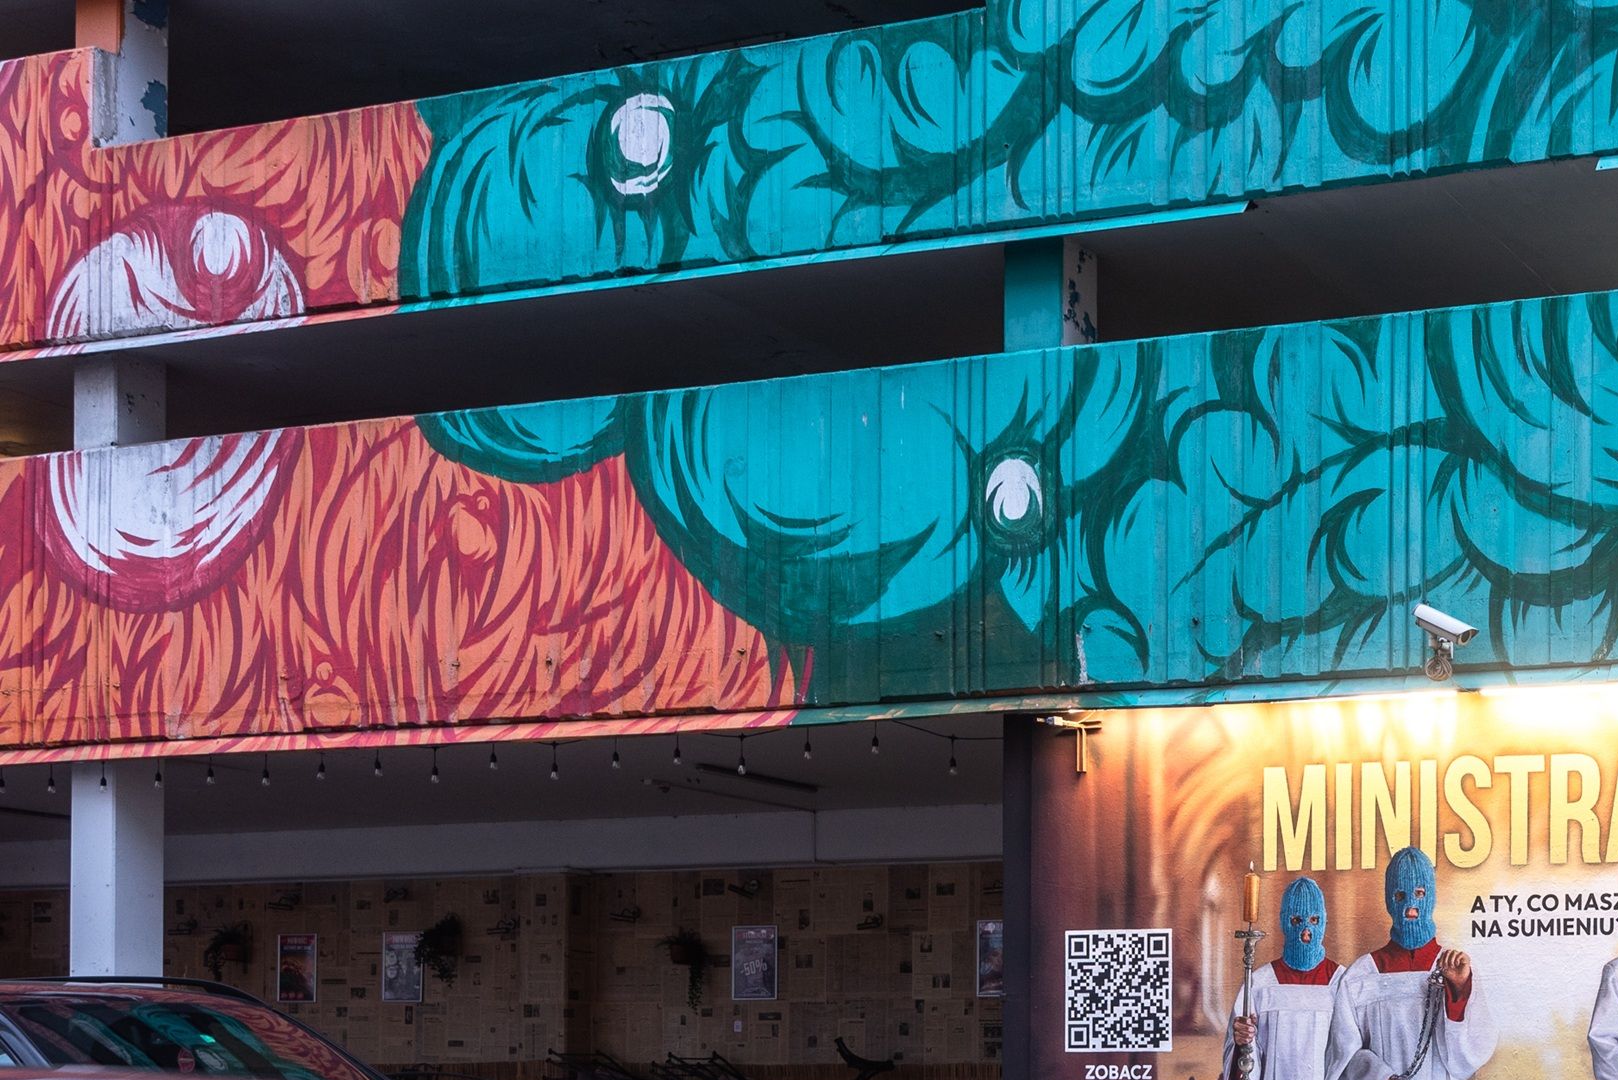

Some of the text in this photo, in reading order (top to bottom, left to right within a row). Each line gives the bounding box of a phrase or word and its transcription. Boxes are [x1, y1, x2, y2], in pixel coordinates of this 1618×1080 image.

[1470, 895, 1486, 914] A
[1489, 894, 1522, 916] TY,
[1526, 893, 1559, 912] CO
[1471, 919, 1503, 938] NA
[1084, 1064, 1153, 1080] ZOBACZ
